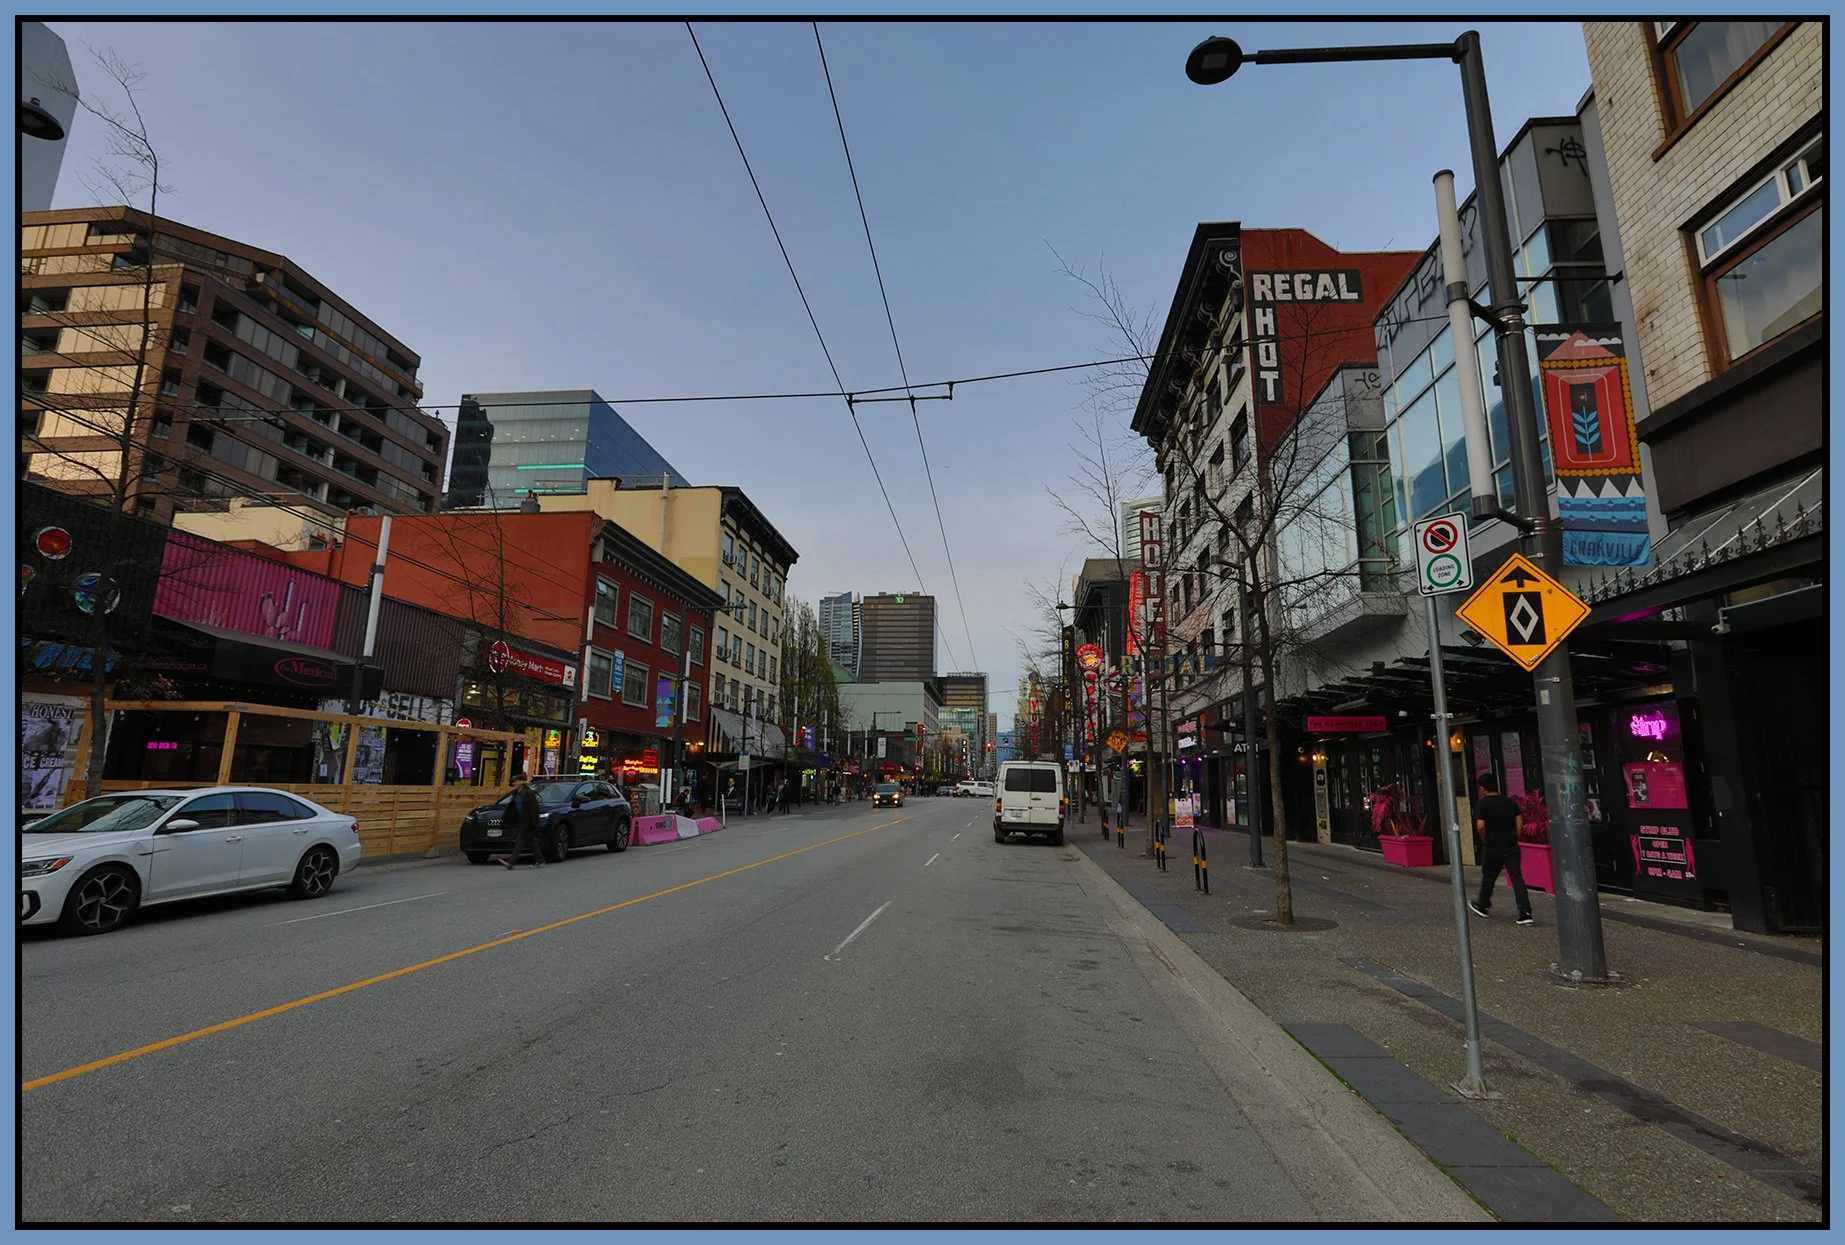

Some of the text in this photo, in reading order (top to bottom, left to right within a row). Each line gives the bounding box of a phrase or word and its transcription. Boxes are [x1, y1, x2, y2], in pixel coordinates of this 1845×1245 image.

[1253, 272, 1359, 301] REGAL
[1254, 308, 1280, 402] HOT
[1570, 539, 1643, 560] GRANVILLE
[1432, 564, 1455, 573] LOADING
[895, 596, 904, 604] TD
[386, 693, 427, 722] SELL
[1660, 826, 1679, 837] CLUB
